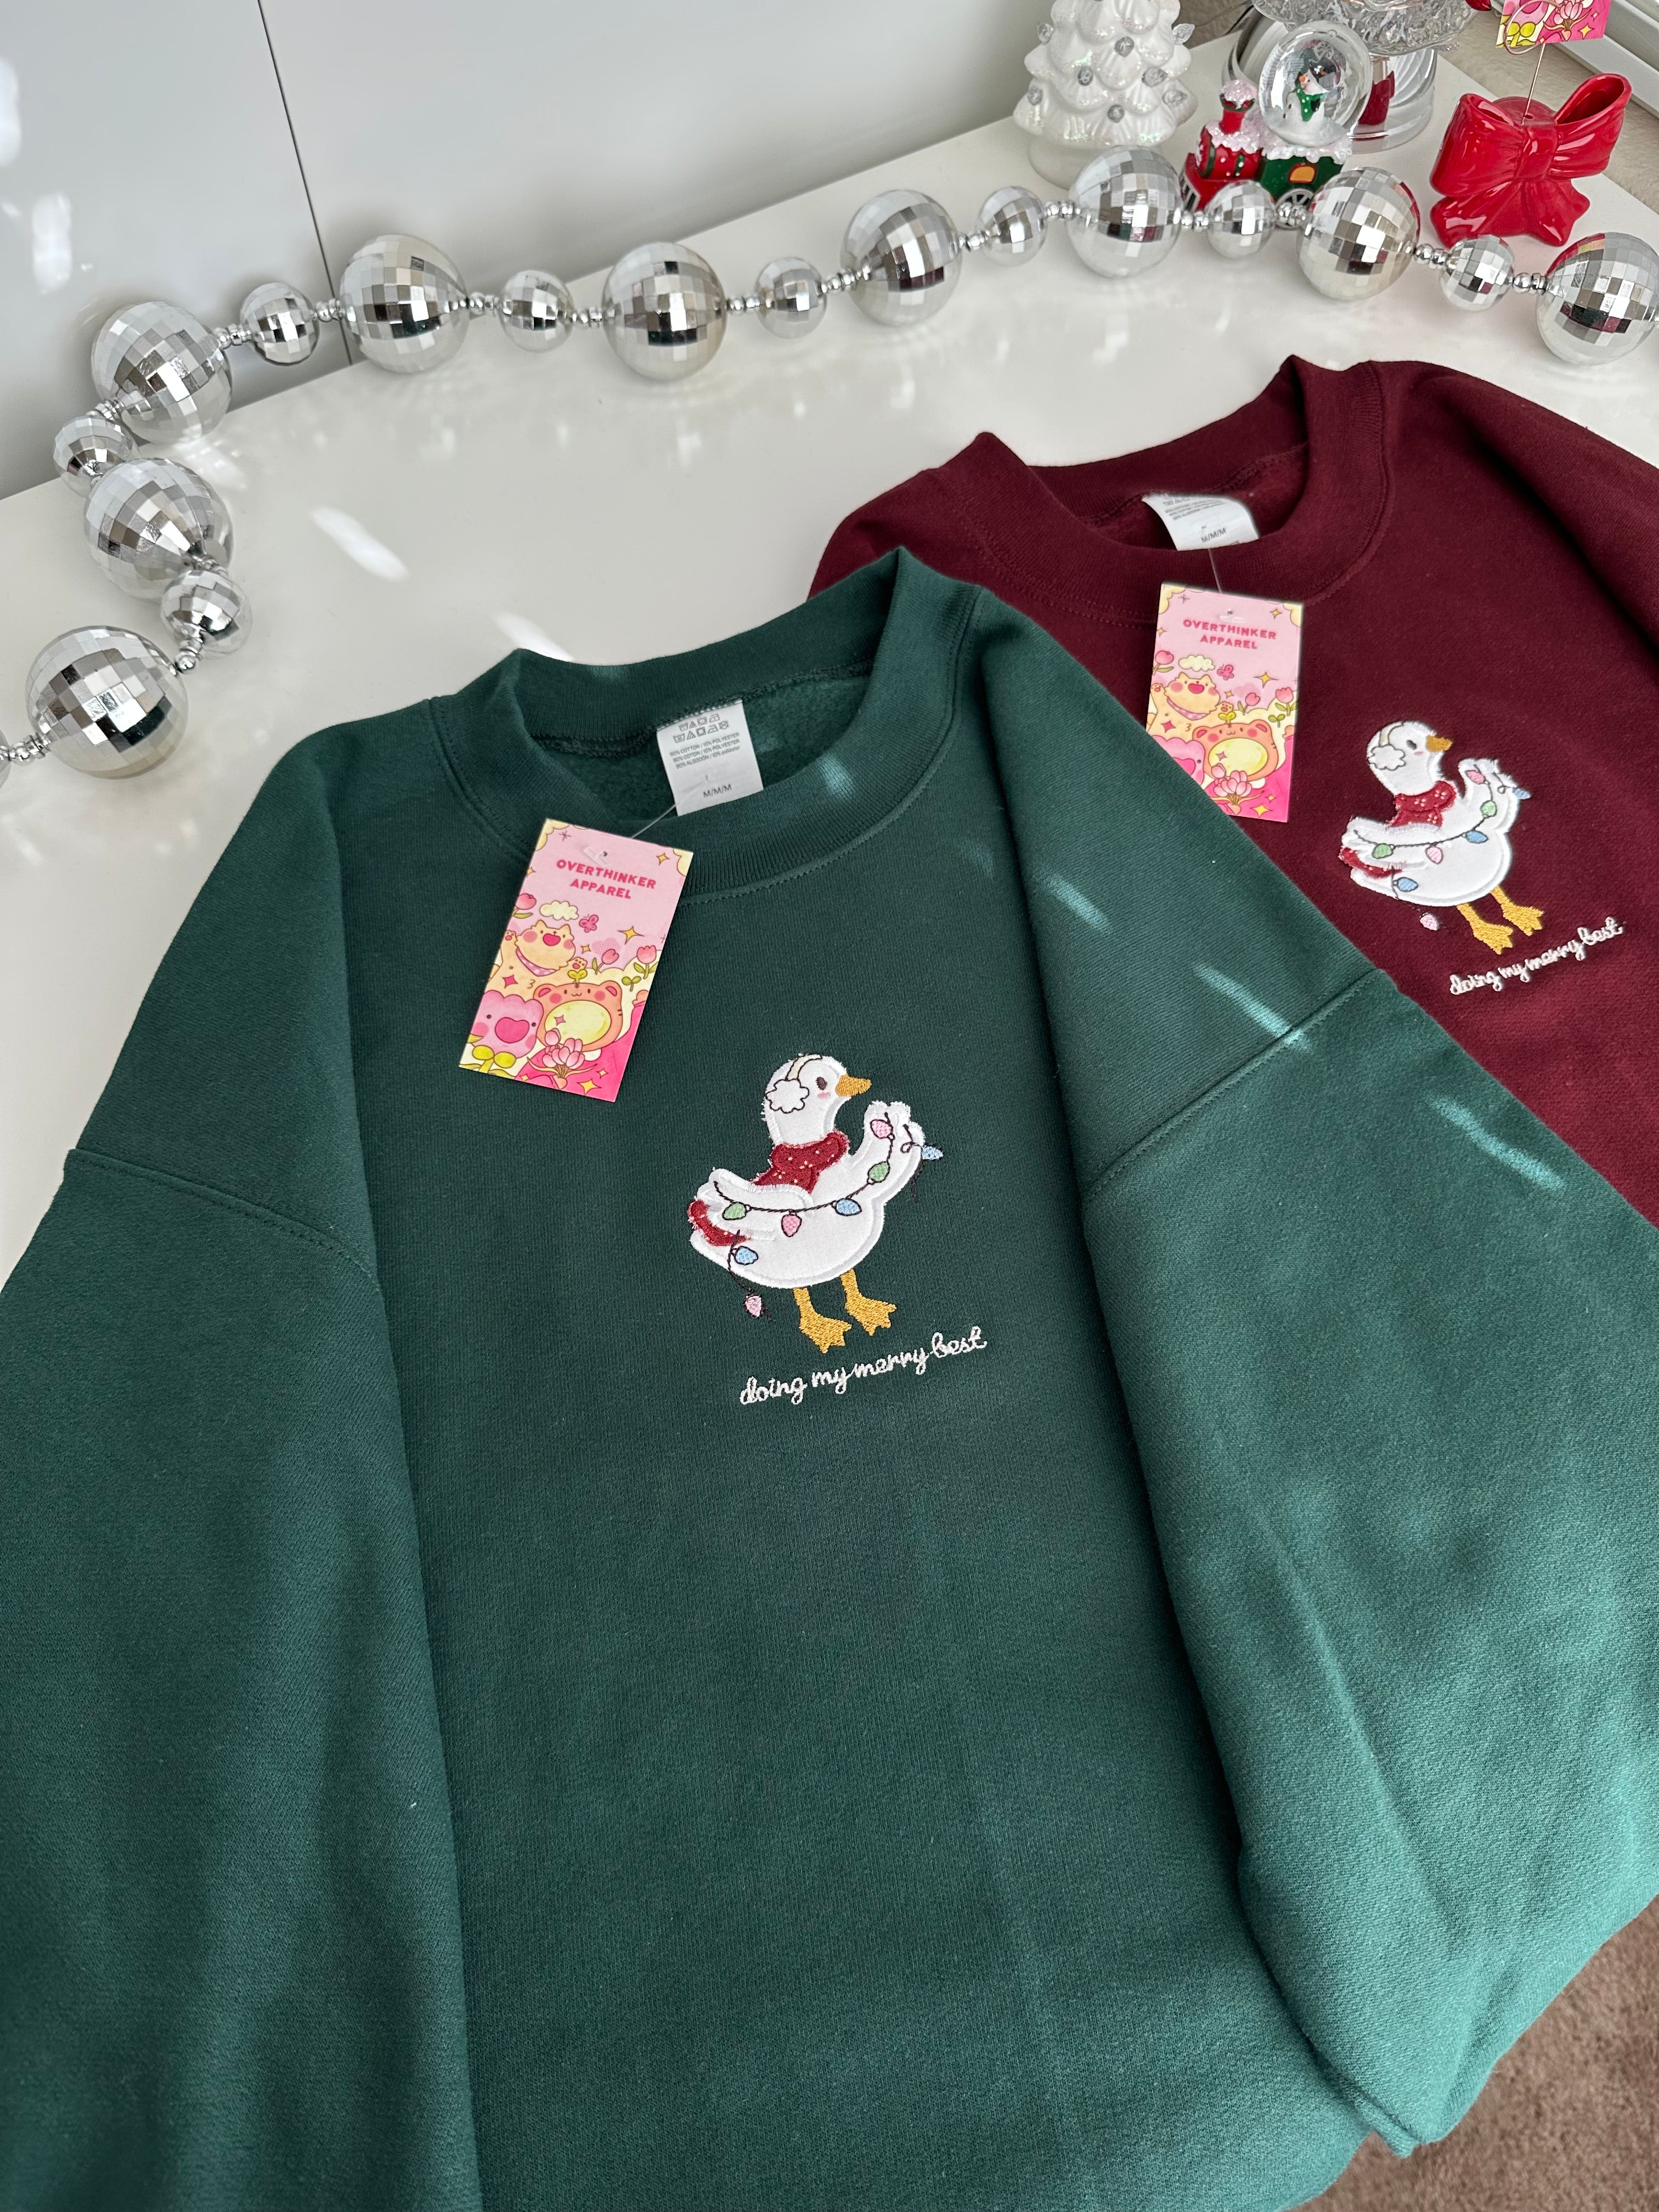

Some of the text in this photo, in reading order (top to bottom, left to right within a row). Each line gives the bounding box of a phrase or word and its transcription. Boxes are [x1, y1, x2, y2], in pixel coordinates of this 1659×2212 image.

[1201, 528, 1226, 543] M/M/M
[1183, 619, 1277, 640] OVERTHINKER
[1200, 635, 1257, 650] APPAREL
[680, 744, 700, 753] COTTON
[712, 732, 740, 743] POLYESTER
[683, 751, 700, 759] COTON
[712, 739, 740, 751] POLYESTER
[703, 784, 732, 798] M/M/M
[556, 860, 656, 889] OVERTHINKER
[570, 879, 631, 899] APPAREL
[1450, 916, 1624, 995] doing my merry best
[740, 1325, 987, 1404] doing my merry best
